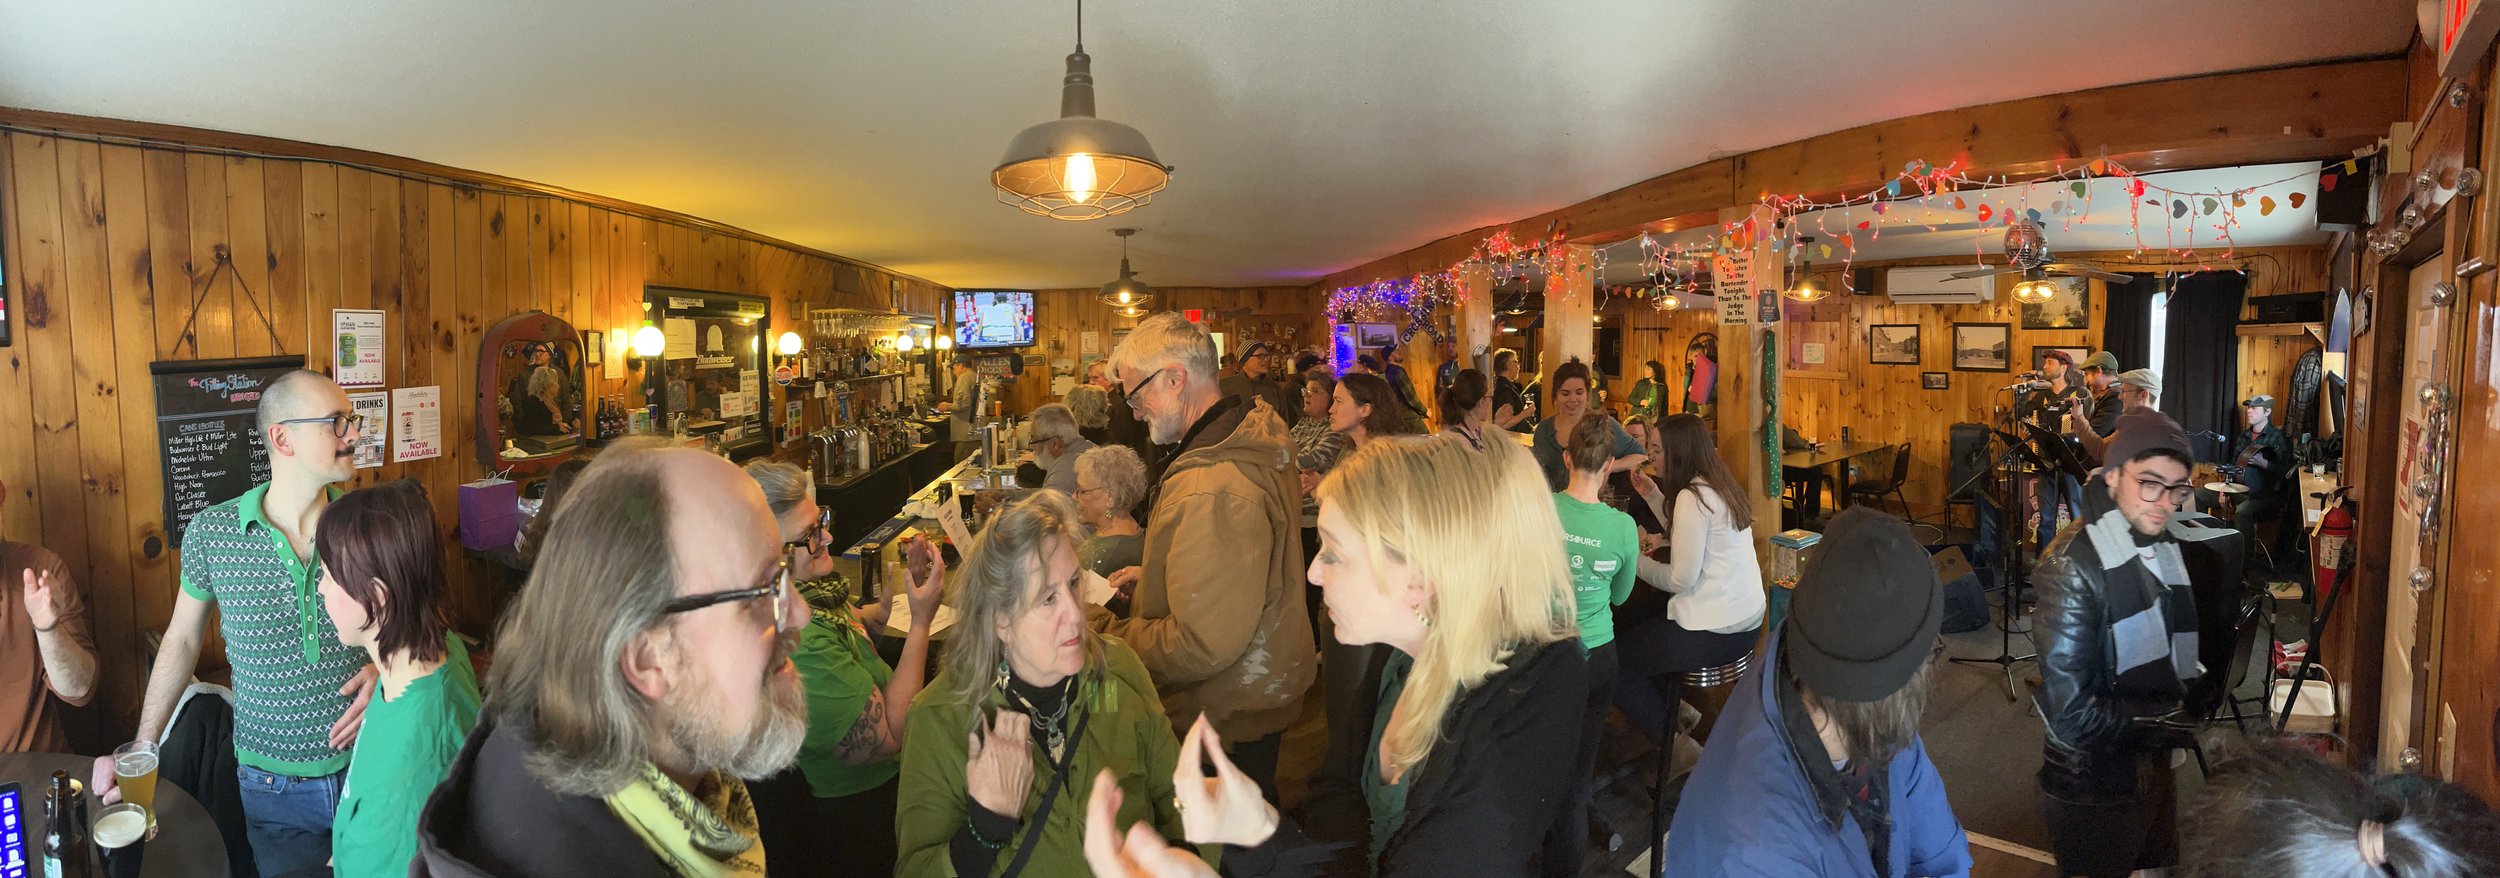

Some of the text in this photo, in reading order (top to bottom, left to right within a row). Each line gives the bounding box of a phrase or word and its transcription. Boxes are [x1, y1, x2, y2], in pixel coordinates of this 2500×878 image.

[696, 354, 734, 365] Budweiser
[979, 357, 1011, 366] ALLEN
[977, 366, 1003, 375] DIGGS
[187, 377, 199, 388] The
[227, 373, 265, 391] Station
[356, 398, 384, 410] DRINKS
[179, 422, 198, 432] CANS
[200, 420, 225, 429] BOTTLES
[168, 436, 183, 445] Miller
[226, 431, 238, 440] Lite
[201, 442, 213, 451] Bud
[213, 440, 230, 455] Light
[409, 441, 429, 450] NOW
[400, 448, 438, 459] AVAILABLE
[170, 465, 191, 474] Corona
[174, 479, 204, 493] High Noon
[194, 499, 210, 509] Blue
[1564, 533, 1601, 547] RSOURCE
